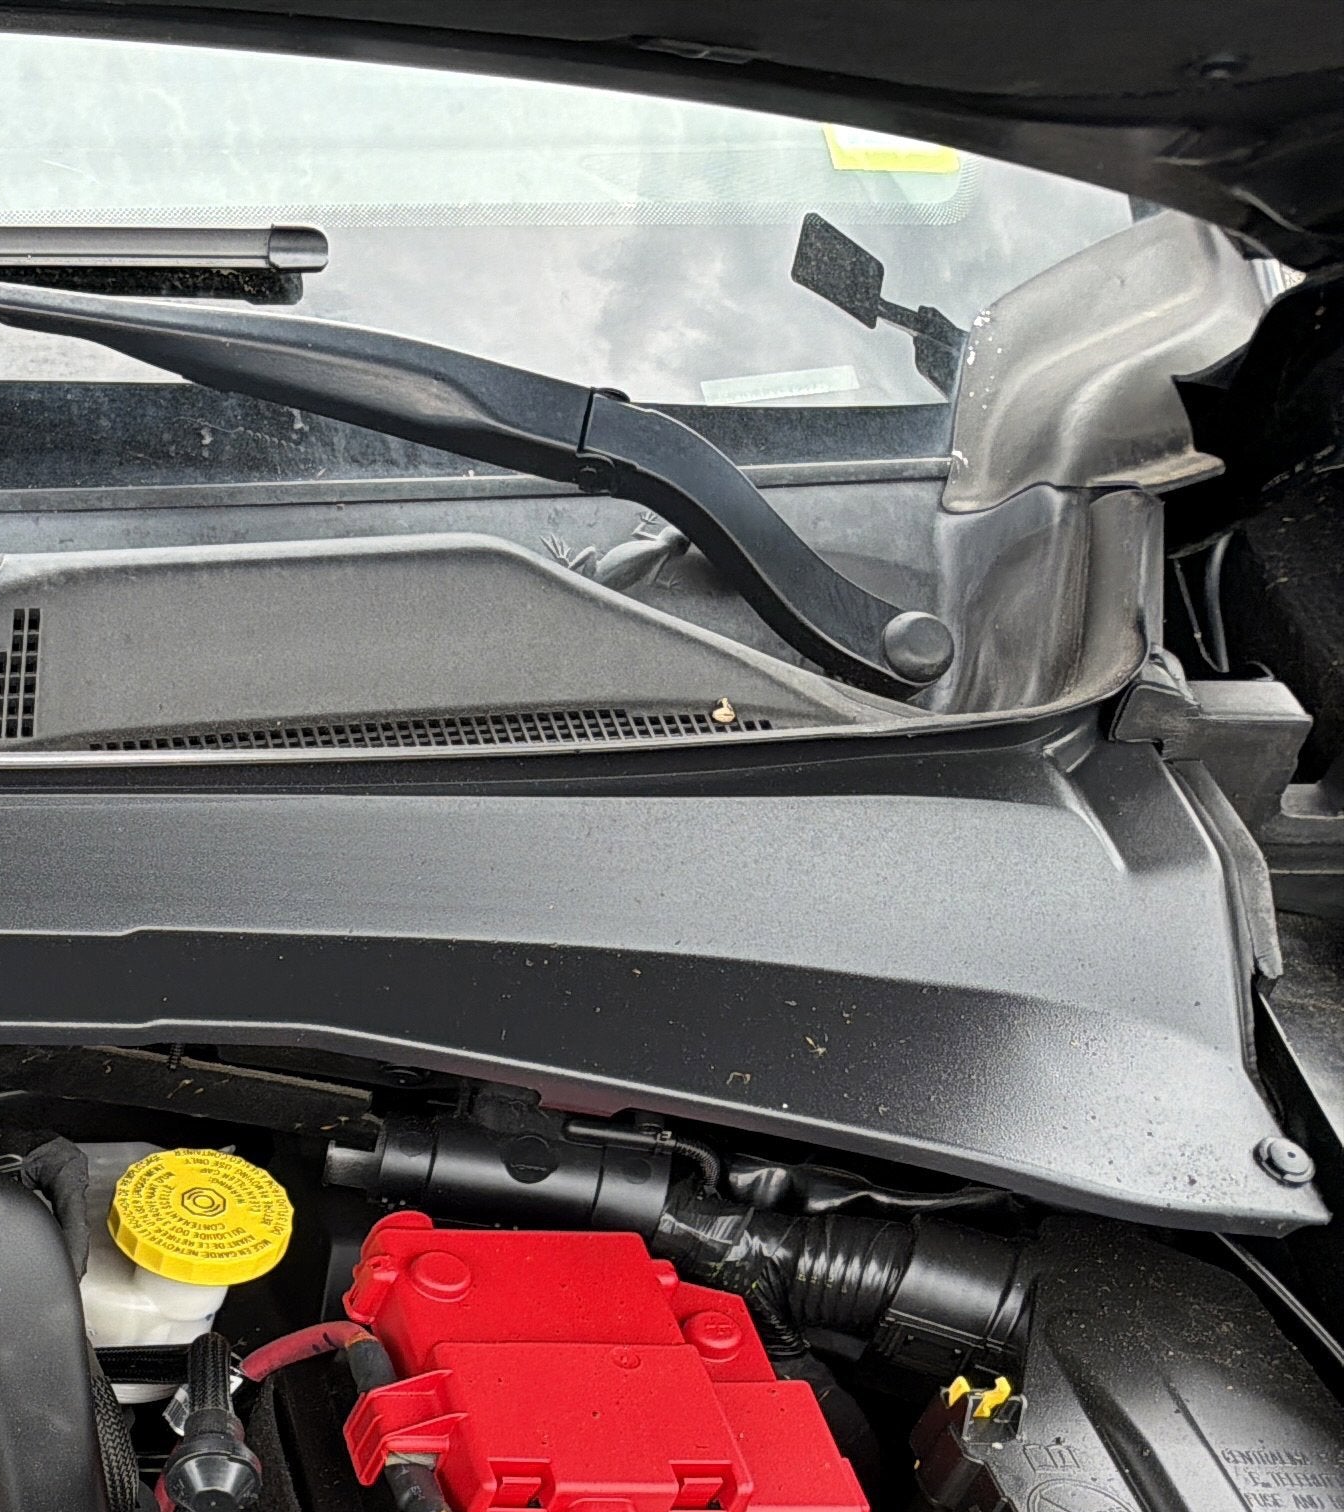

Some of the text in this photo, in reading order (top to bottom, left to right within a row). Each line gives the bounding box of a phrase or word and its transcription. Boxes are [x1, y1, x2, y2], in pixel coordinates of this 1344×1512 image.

[211, 1159, 233, 1171] USE
[163, 1209, 228, 1233] CONTENANT
[168, 1224, 191, 1237] DOT
[191, 1230, 234, 1241] LIQUIDE
[230, 1225, 247, 1237] DU
[197, 1241, 209, 1250] LE
[211, 1241, 227, 1250] DE
[226, 1233, 257, 1249] AVANT
[235, 1246, 253, 1258] EN
